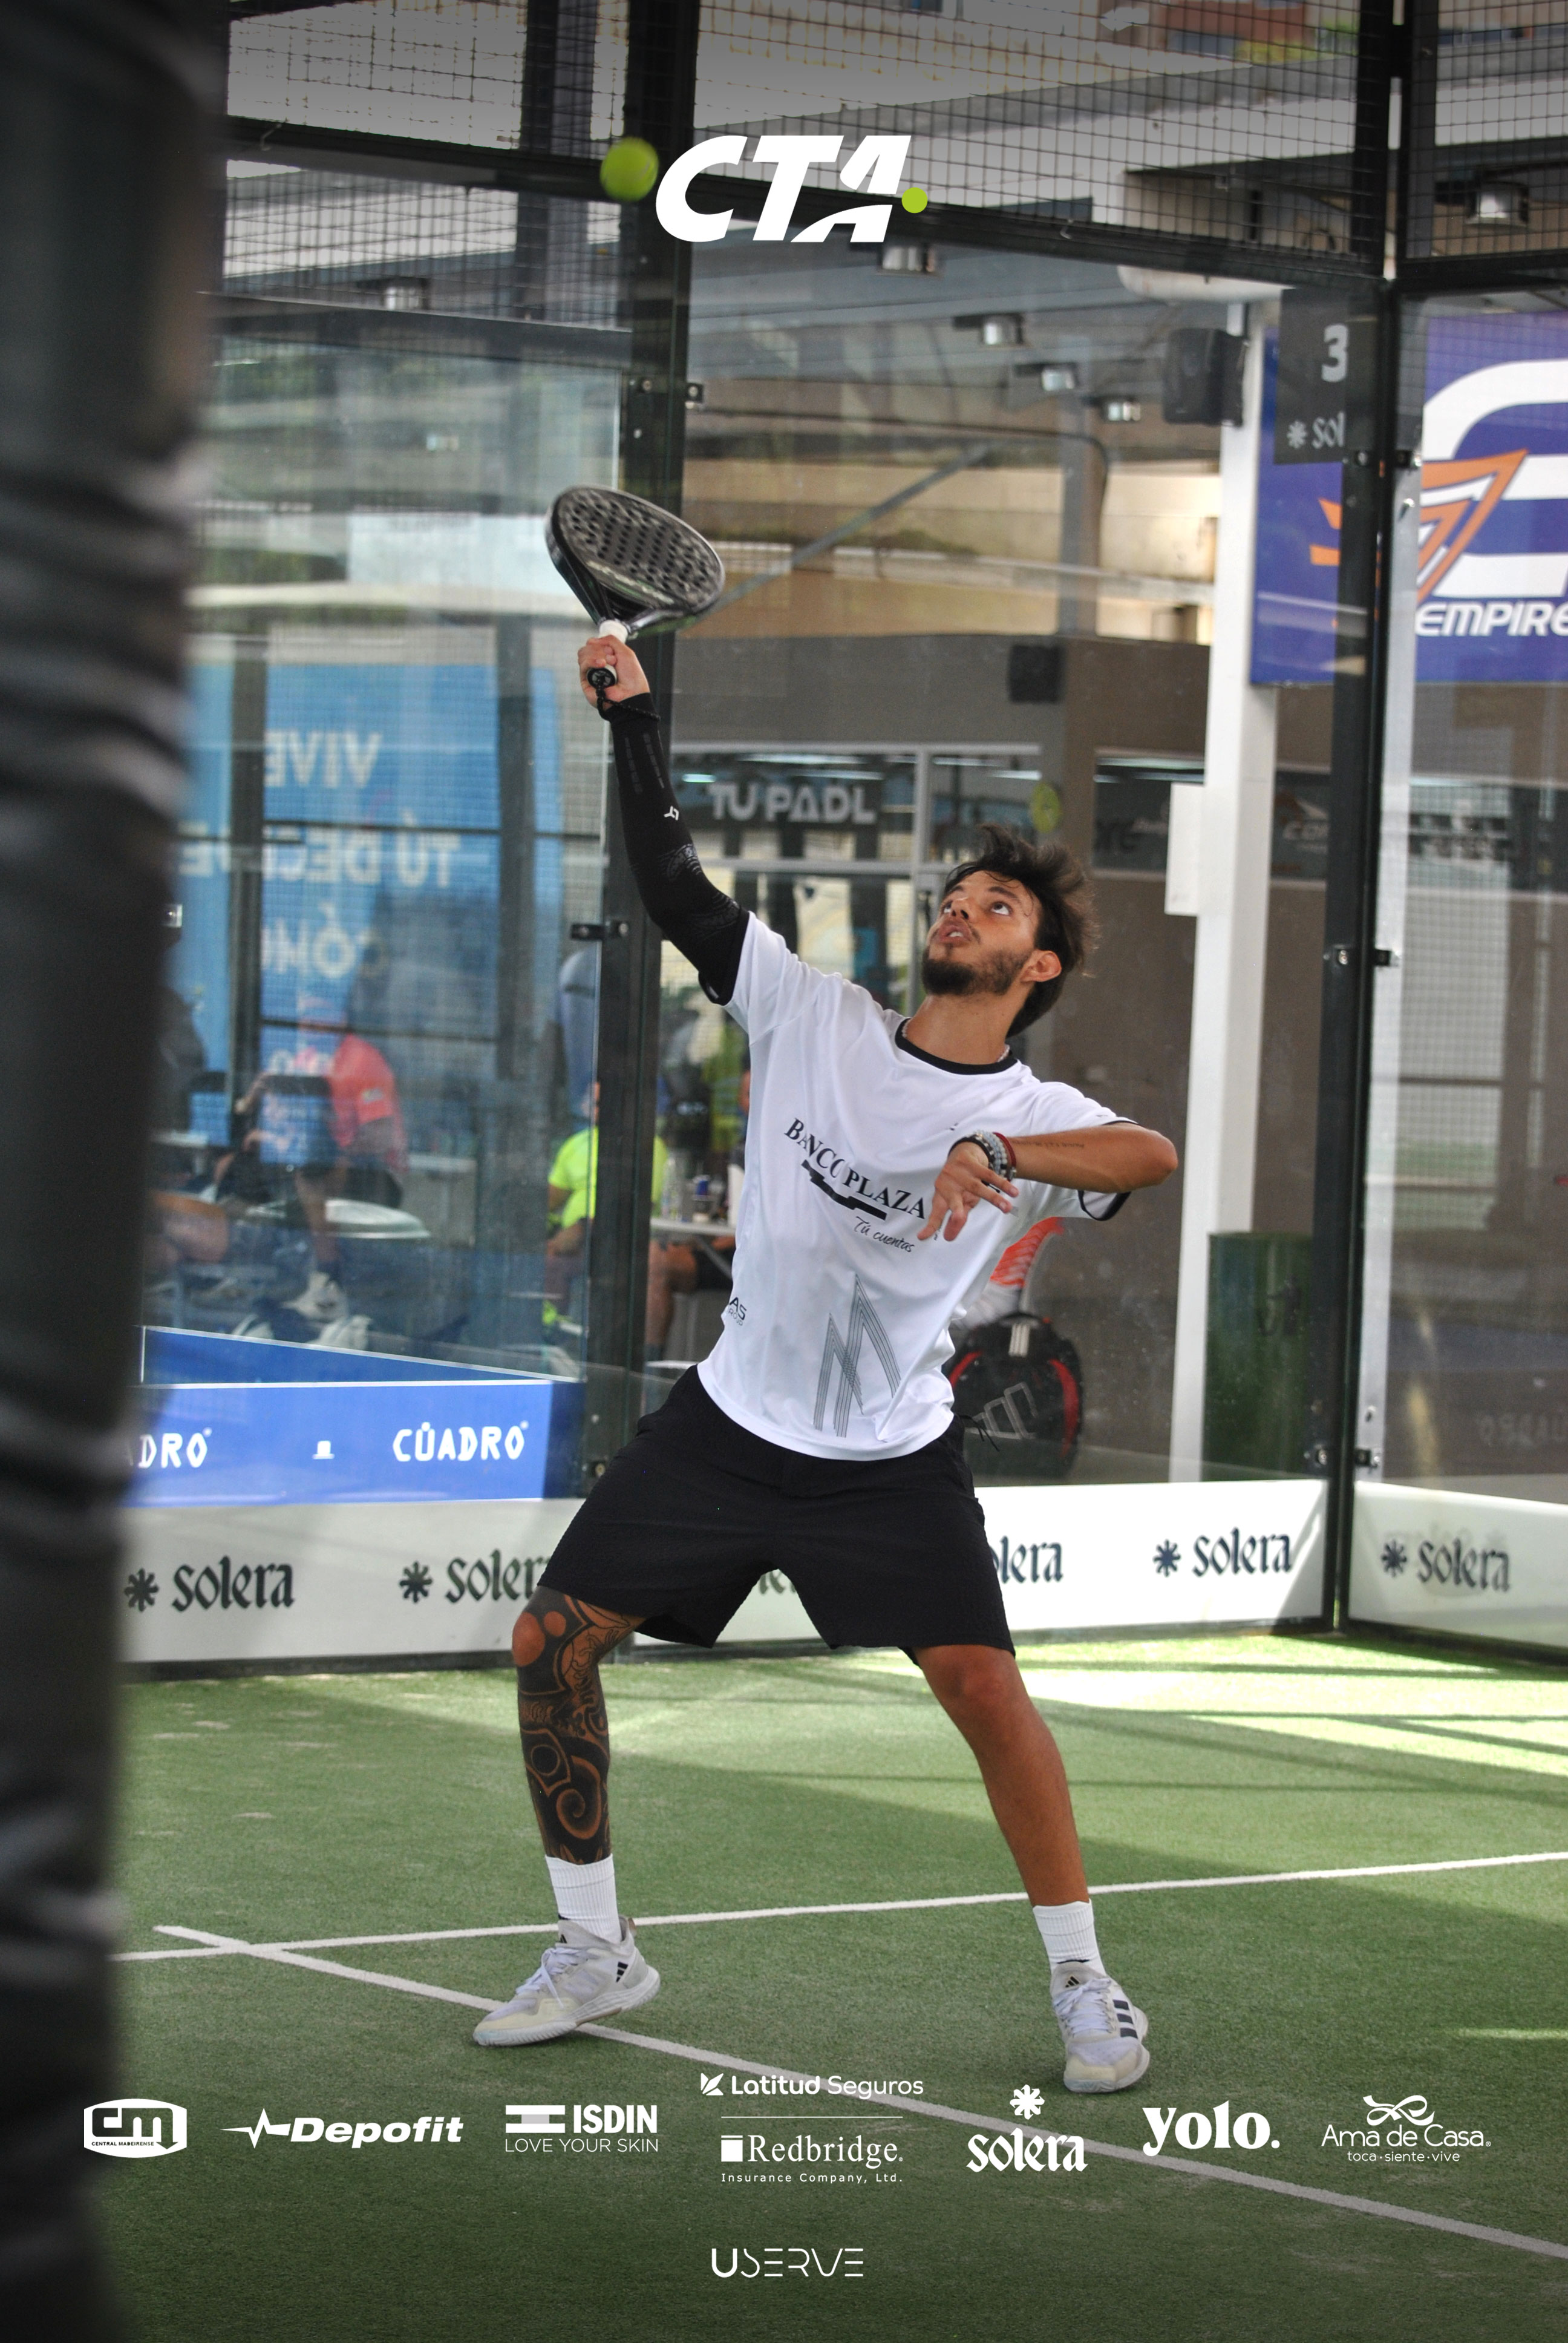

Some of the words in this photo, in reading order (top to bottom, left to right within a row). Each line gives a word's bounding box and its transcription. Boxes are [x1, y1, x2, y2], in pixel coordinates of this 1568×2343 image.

[1321, 324, 1349, 382] 3
[707, 781, 758, 821] TU
[765, 782, 878, 825] PADL
[784, 1118, 845, 1178] BANCO
[842, 1167, 926, 1219] PLAZA
[854, 1216, 872, 1236] Tú
[873, 1230, 915, 1253] cuentas
[126, 1432, 208, 1469] DRO
[445, 1548, 552, 1604] soler
[1191, 1526, 1292, 1578] solera
[1417, 1536, 1511, 1593] solera
[171, 1555, 295, 1611] solera
